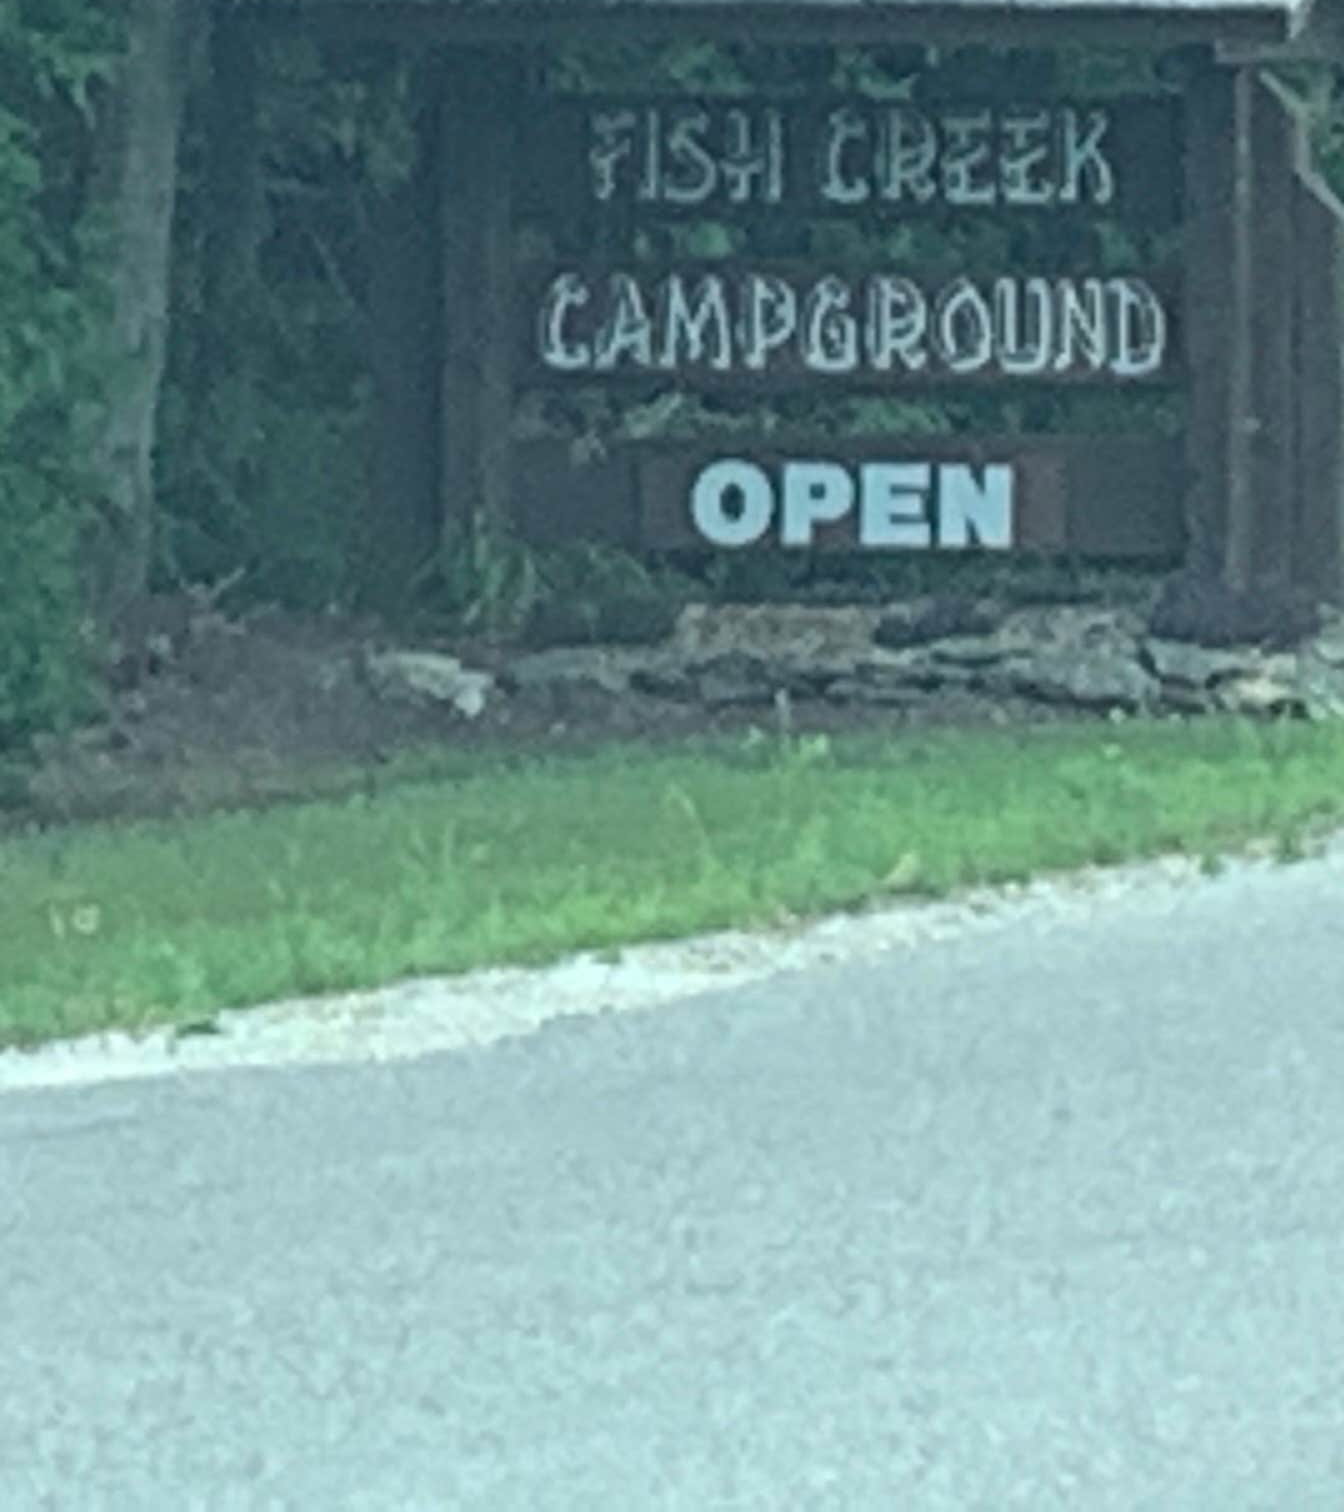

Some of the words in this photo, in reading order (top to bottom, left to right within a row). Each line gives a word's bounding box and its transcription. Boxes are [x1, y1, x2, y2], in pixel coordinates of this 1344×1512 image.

[589, 107, 783, 204] FISH
[820, 107, 1114, 206] CREEK
[541, 272, 1168, 374] CAMPGROUND
[690, 457, 1015, 550] OPEN
